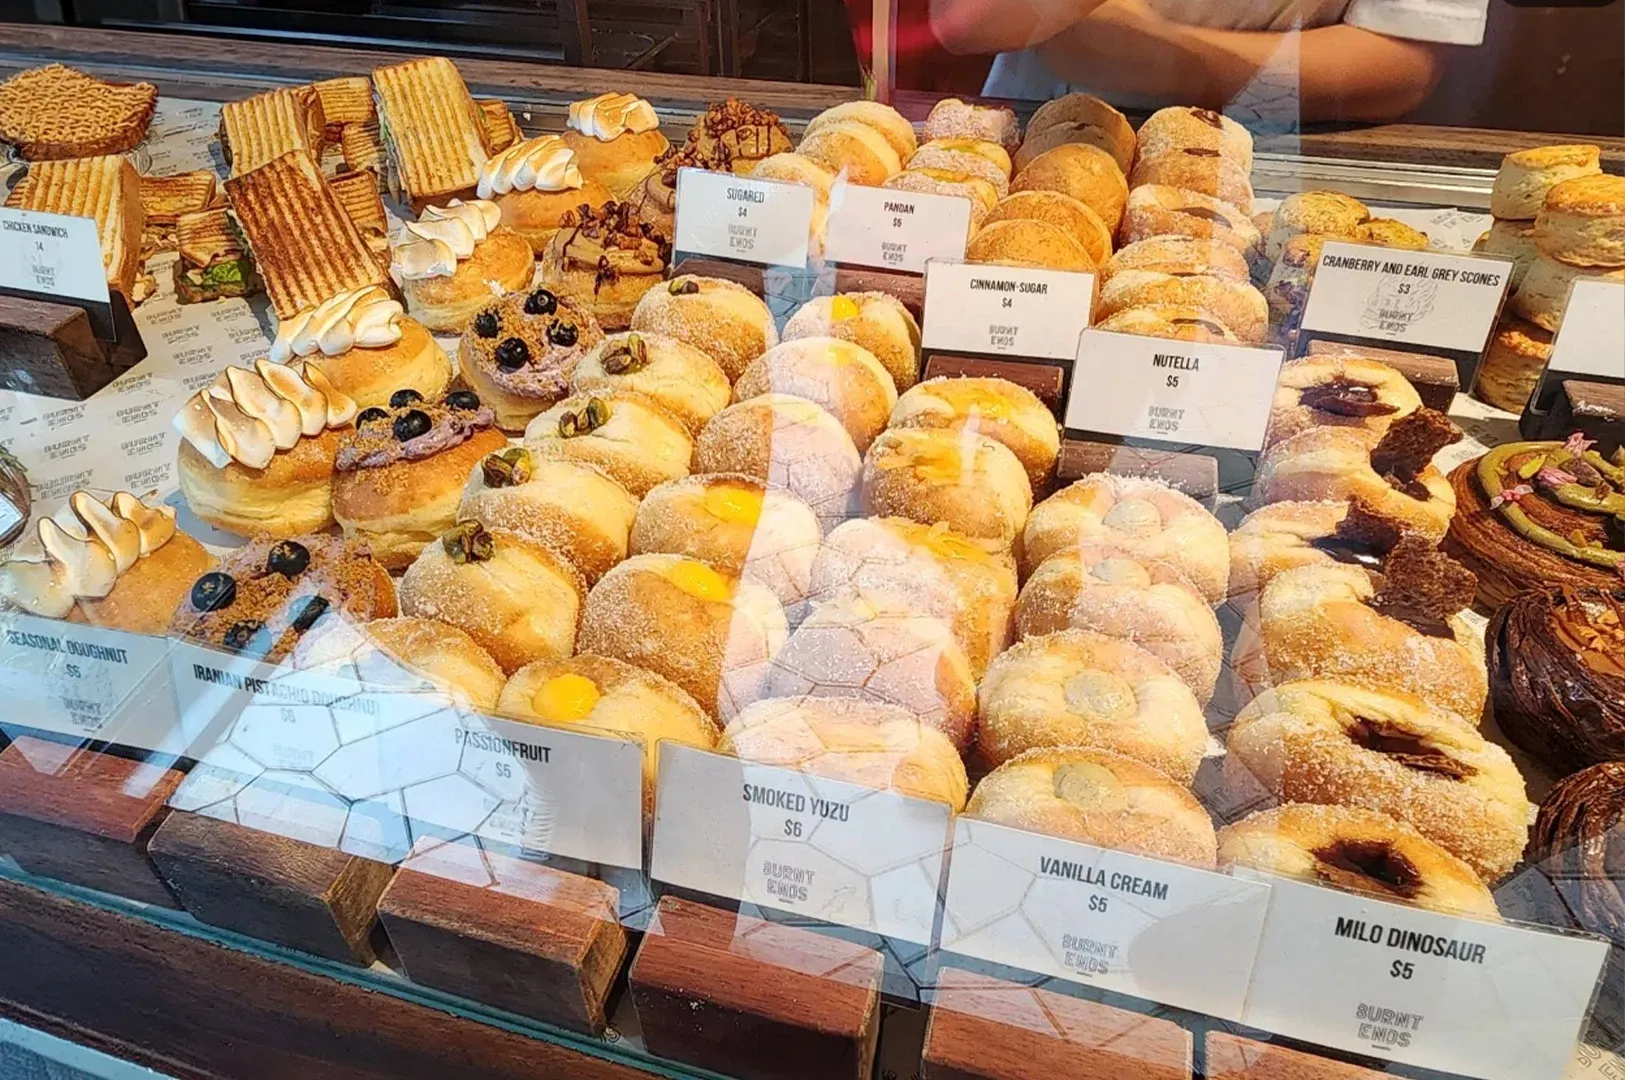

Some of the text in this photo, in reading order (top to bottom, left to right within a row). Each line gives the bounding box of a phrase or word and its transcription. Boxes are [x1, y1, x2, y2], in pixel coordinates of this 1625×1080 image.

[726, 187, 765, 203] SUGARED
[737, 206, 747, 217] $4
[884, 201, 915, 215] PANDAN
[3, 220, 69, 239] CHICKEN SANDWICH
[1322, 254, 1501, 287] CRANBERRY AND EARL GREY SCONES
[970, 279, 1048, 294] CINNAMON-SUGAR
[1397, 283, 1411, 295] $3
[1001, 297, 1012, 308] $4
[1152, 353, 1199, 371] NUTELLA
[1165, 375, 1179, 388] $5
[7, 630, 128, 664] SEASONAL DOUGHNUT
[66, 664, 81, 678] $6
[193, 664, 242, 690] IRANIAN
[244, 676, 309, 704] PISTACHIO
[455, 728, 552, 763] PASSIONFRUIT
[495, 761, 512, 779] $5
[743, 783, 850, 822] SMOKED YUZU
[784, 818, 802, 837] $6
[763, 860, 815, 885] BURNT
[1040, 856, 1169, 900] VANILLA CREAM
[767, 878, 809, 902] ENDS
[1088, 894, 1108, 913] $5
[1062, 934, 1118, 959] BURNT
[1334, 917, 1487, 964] MILO DINOSAUR
[1064, 951, 1110, 975] ENDS
[1390, 959, 1415, 980] $5
[1356, 1002, 1425, 1031] BURNT
[1358, 1022, 1412, 1048] ENDS
